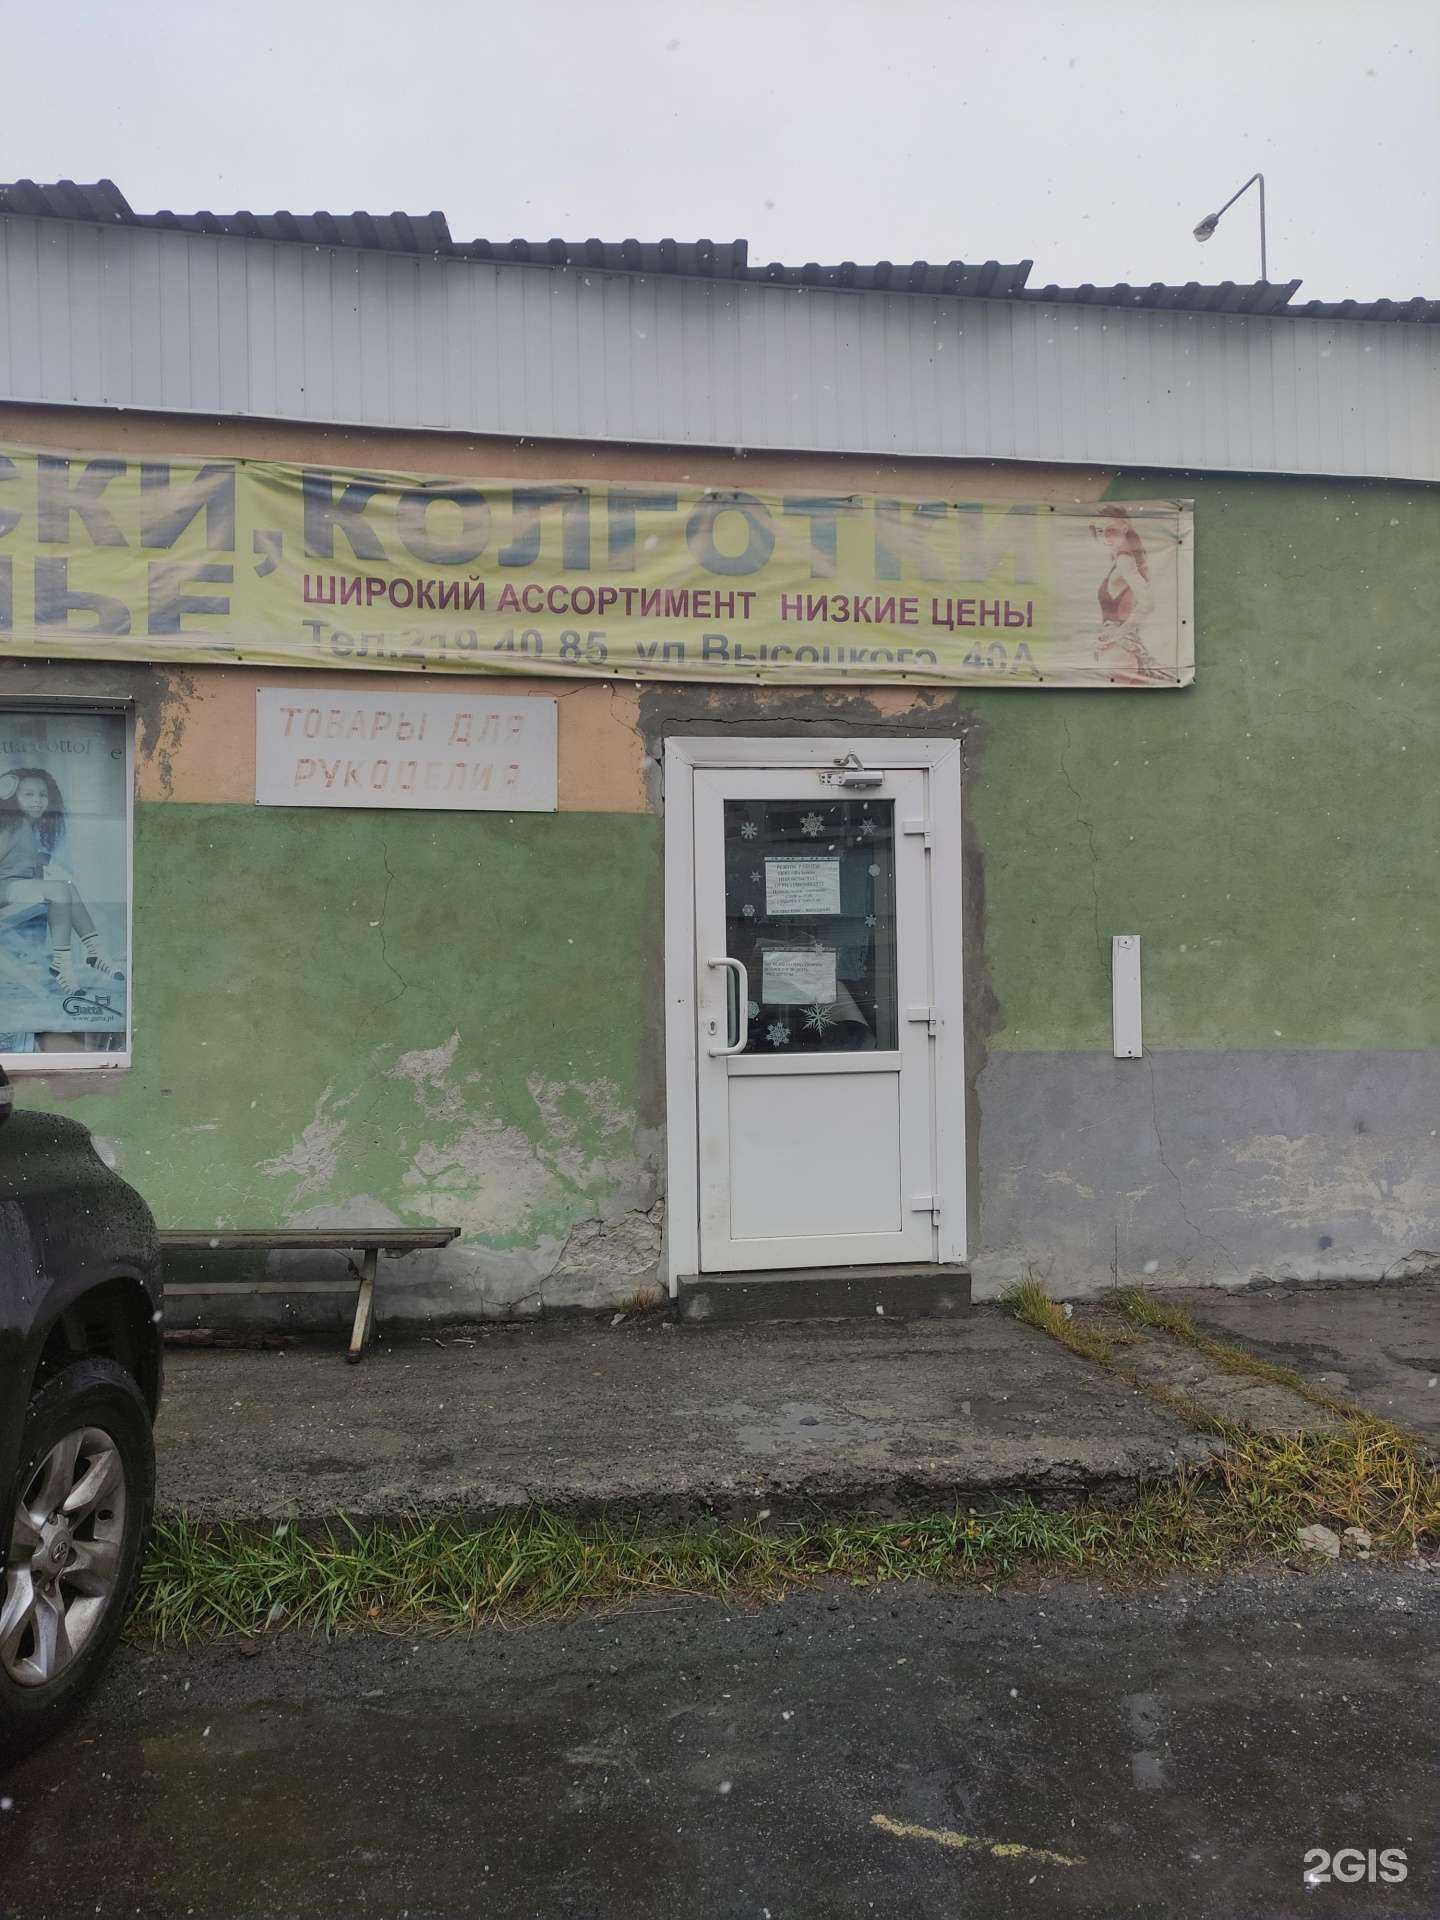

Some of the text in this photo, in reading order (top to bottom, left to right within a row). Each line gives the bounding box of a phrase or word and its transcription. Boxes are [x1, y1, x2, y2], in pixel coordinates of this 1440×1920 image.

[0, 454, 1042, 585] КИ, КОЛГОТКИ
[303, 574, 1034, 631] ШИРОКИЙ АССОРТИМЕНТ НИЗКИЕ ЦЕНЫ
[558, 630, 609, 666] 85
[280, 706, 527, 747] ТОВАРЫ ДЛЯ
